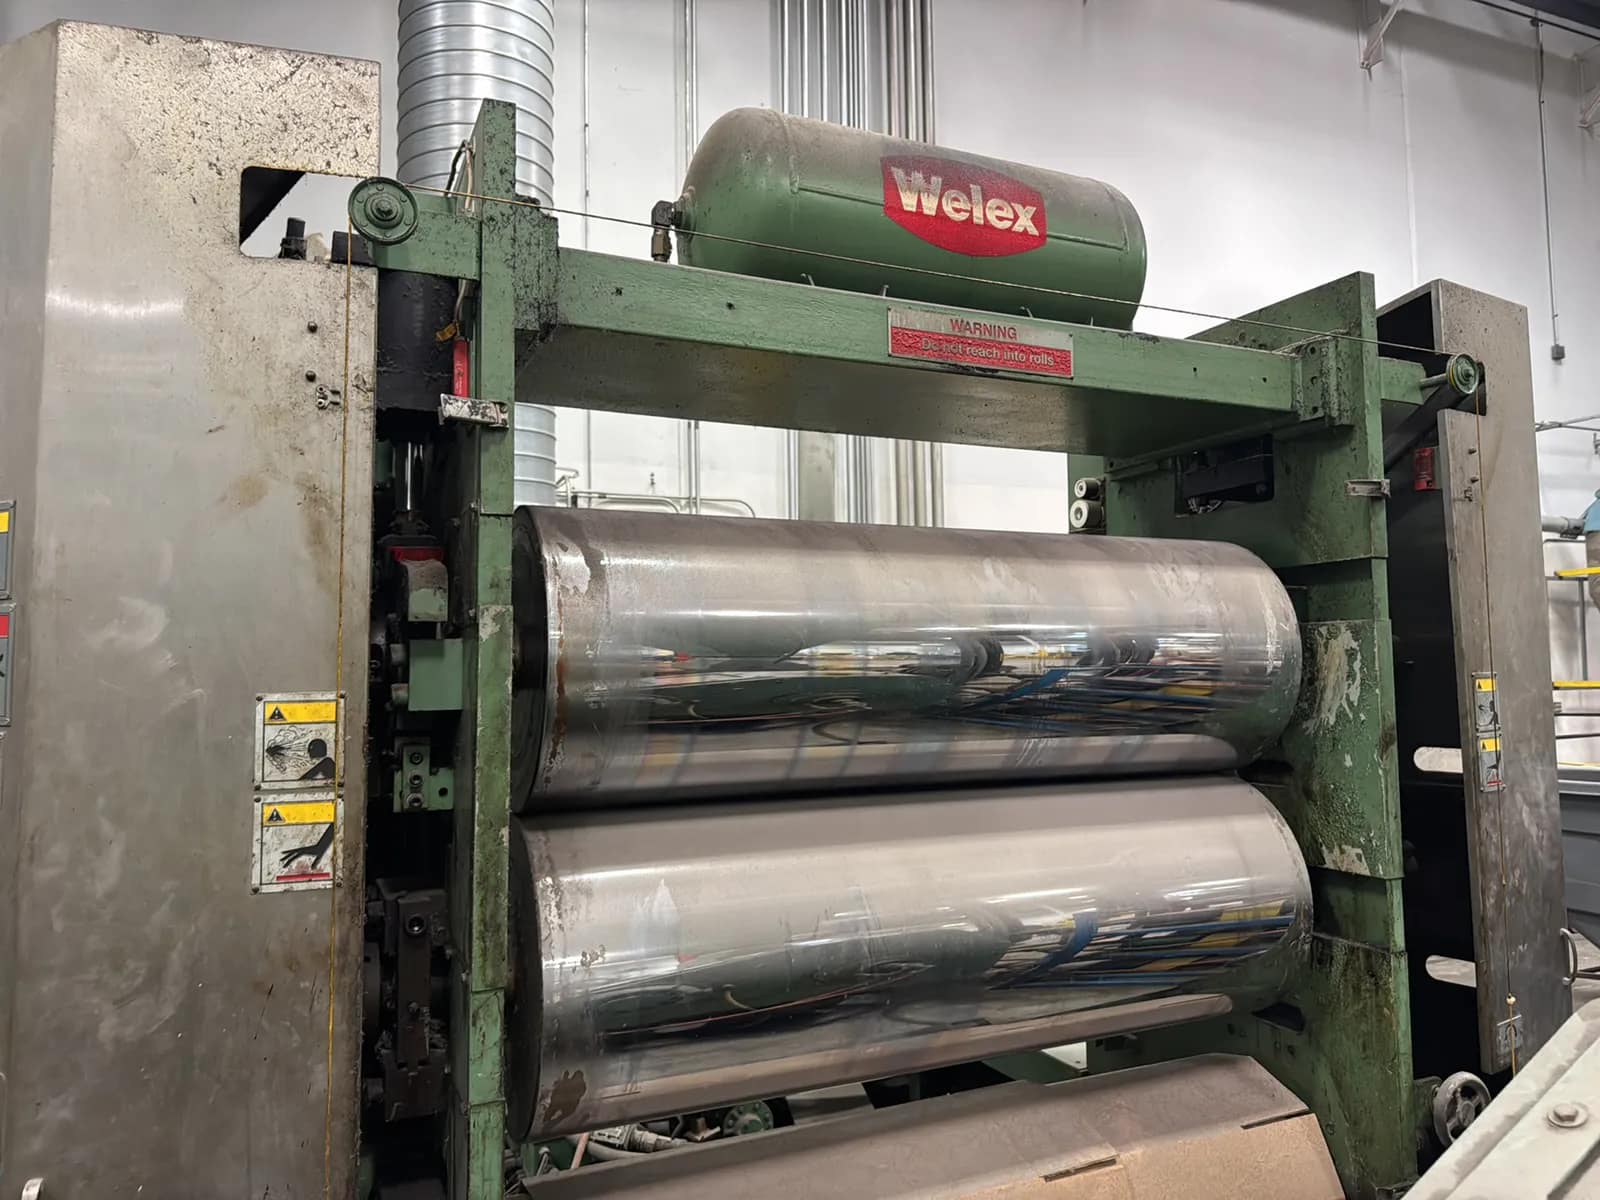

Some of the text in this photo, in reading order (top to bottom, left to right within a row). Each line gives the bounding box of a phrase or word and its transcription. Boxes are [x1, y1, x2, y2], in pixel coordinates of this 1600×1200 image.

[891, 166, 1040, 236] Welex
[950, 318, 1017, 341] WARNING
[921, 337, 1055, 367] Do not reach into rolls
